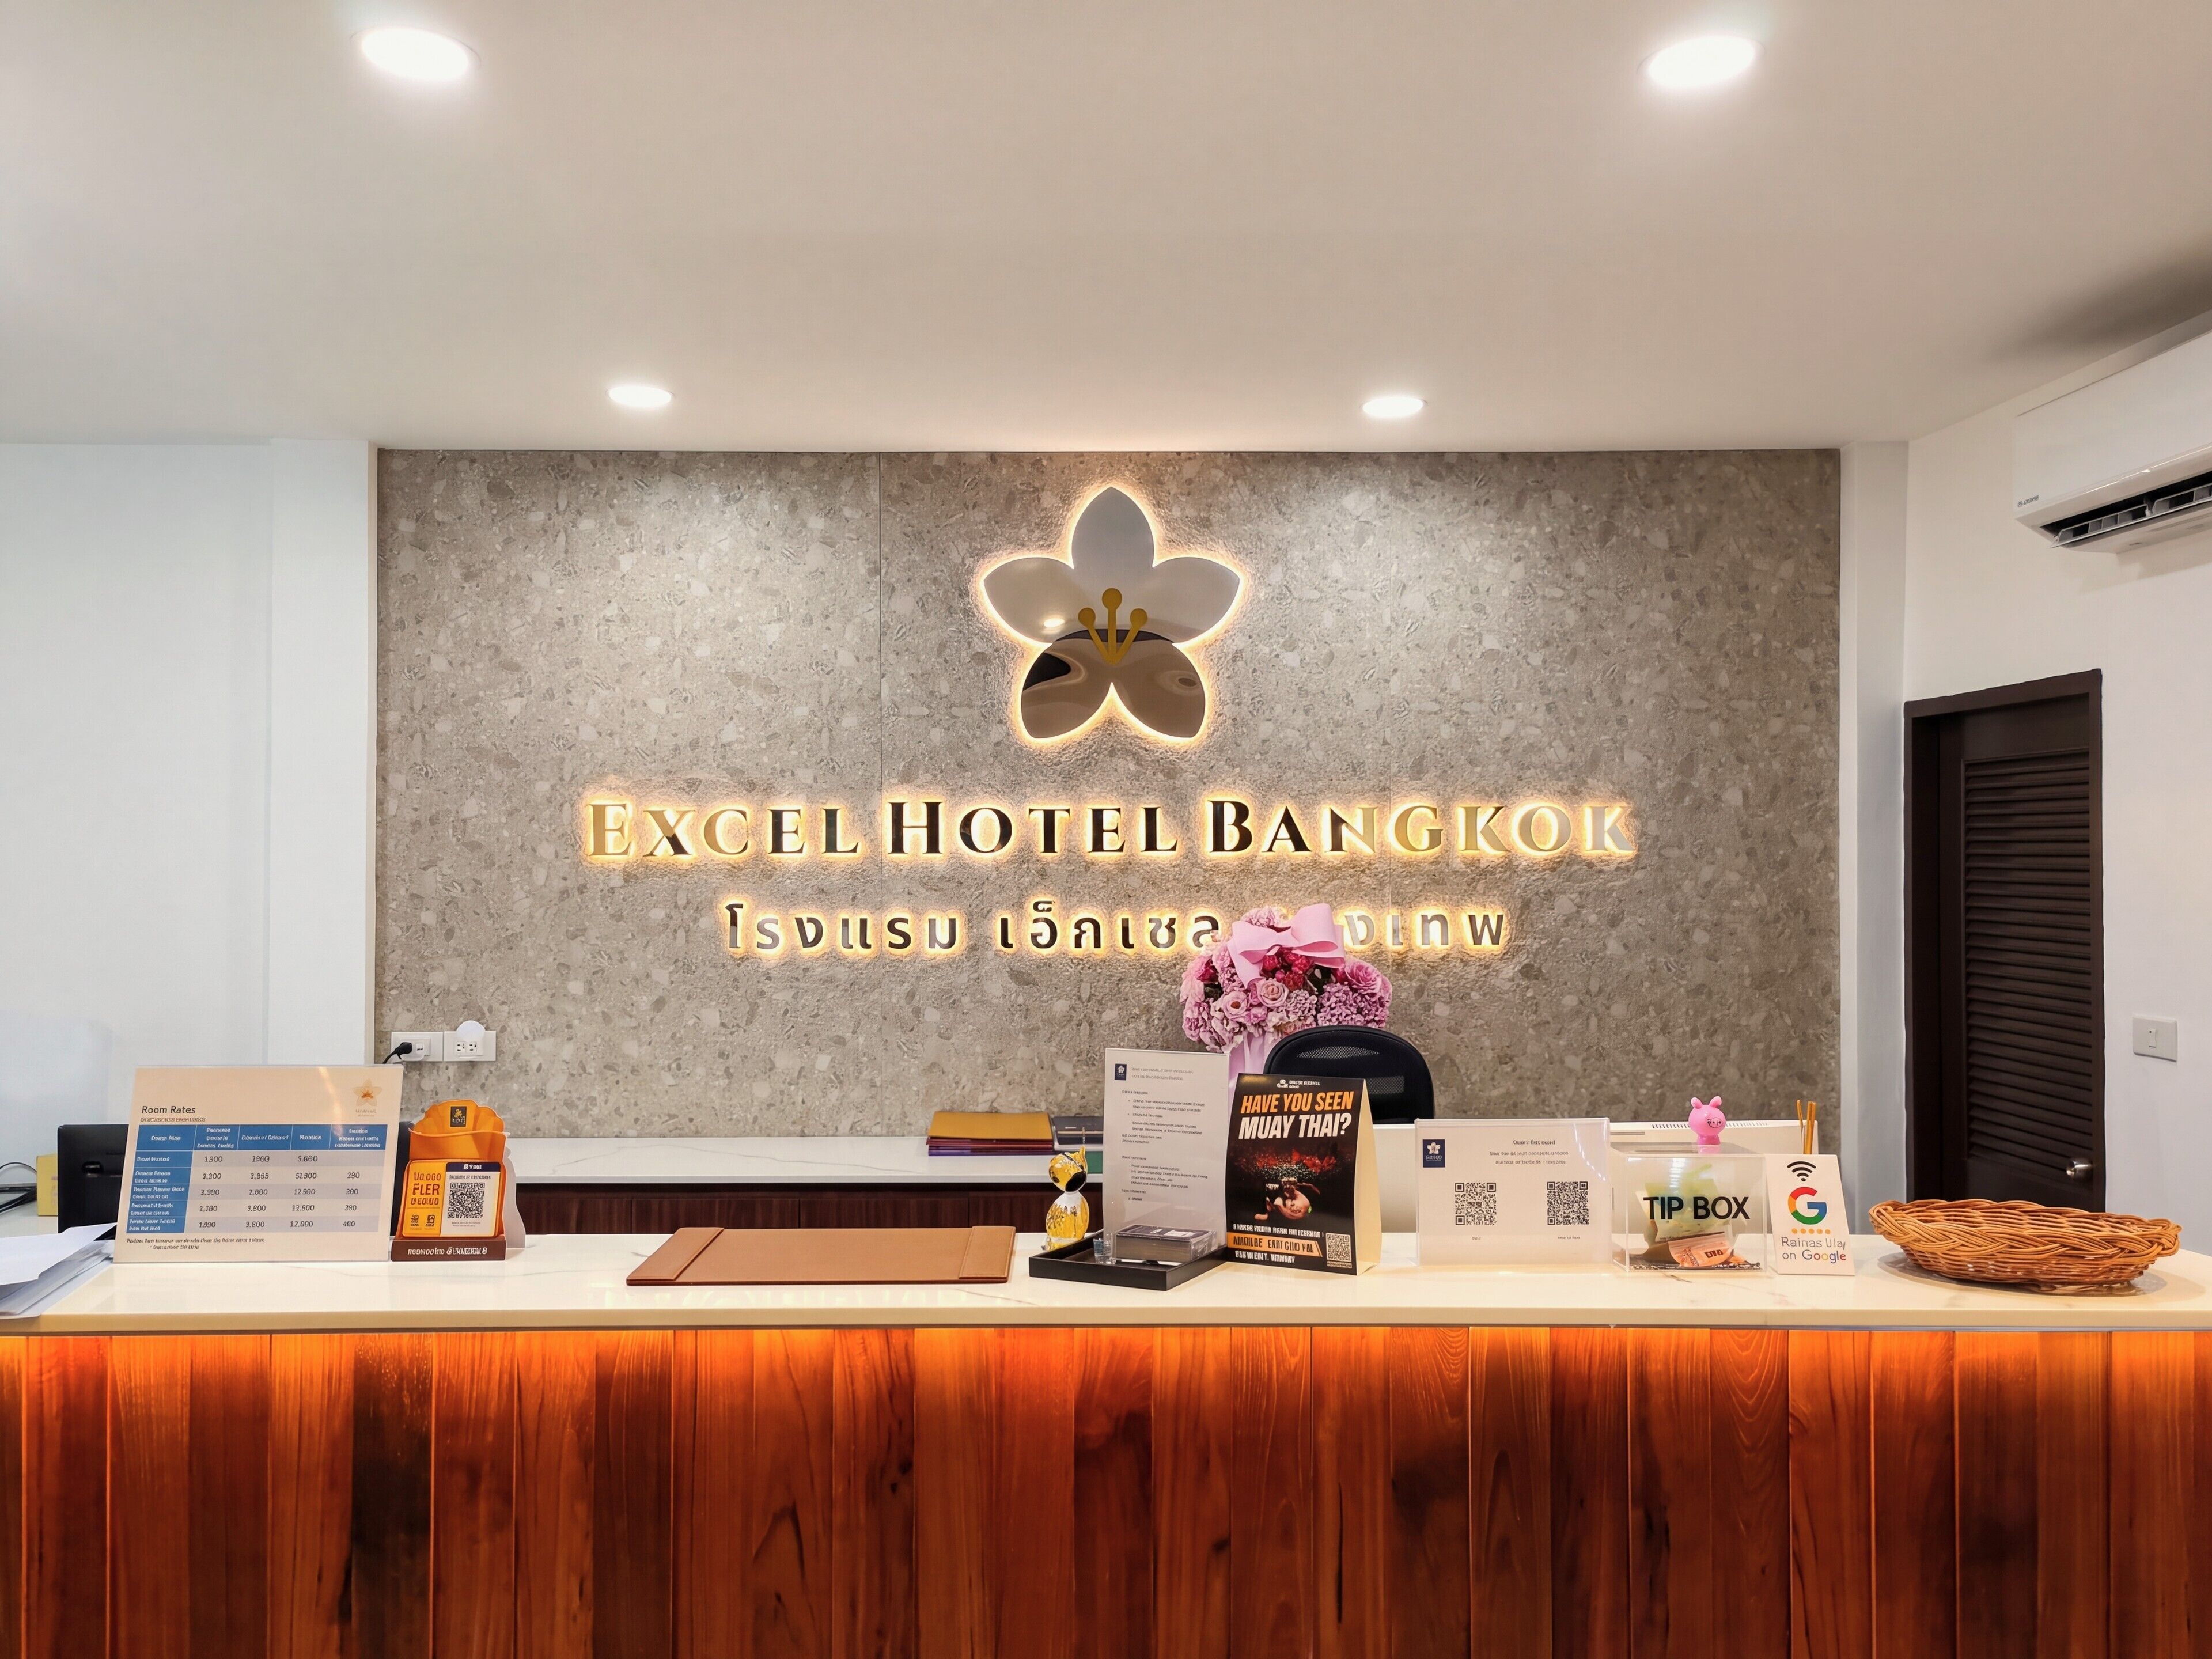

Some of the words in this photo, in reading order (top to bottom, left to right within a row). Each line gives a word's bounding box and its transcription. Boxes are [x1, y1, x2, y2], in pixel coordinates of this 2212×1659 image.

[586, 802, 858, 857] EXCEL
[887, 801, 1177, 855] HOTEL
[1207, 800, 1634, 853] BANGKOK
[725, 903, 956, 949] โรงแรม
[171, 1106, 196, 1114] Rates
[1240, 1095, 1280, 1113] HAVE
[1283, 1093, 1312, 1112] YOU
[1315, 1092, 1354, 1111] SEEN
[1238, 1115, 1295, 1139] MUAY
[1297, 1113, 1352, 1138] THAI?
[1643, 1196, 1684, 1220] TIP
[1693, 1196, 1751, 1219] BOX
[1802, 1249, 1846, 1264] Google
